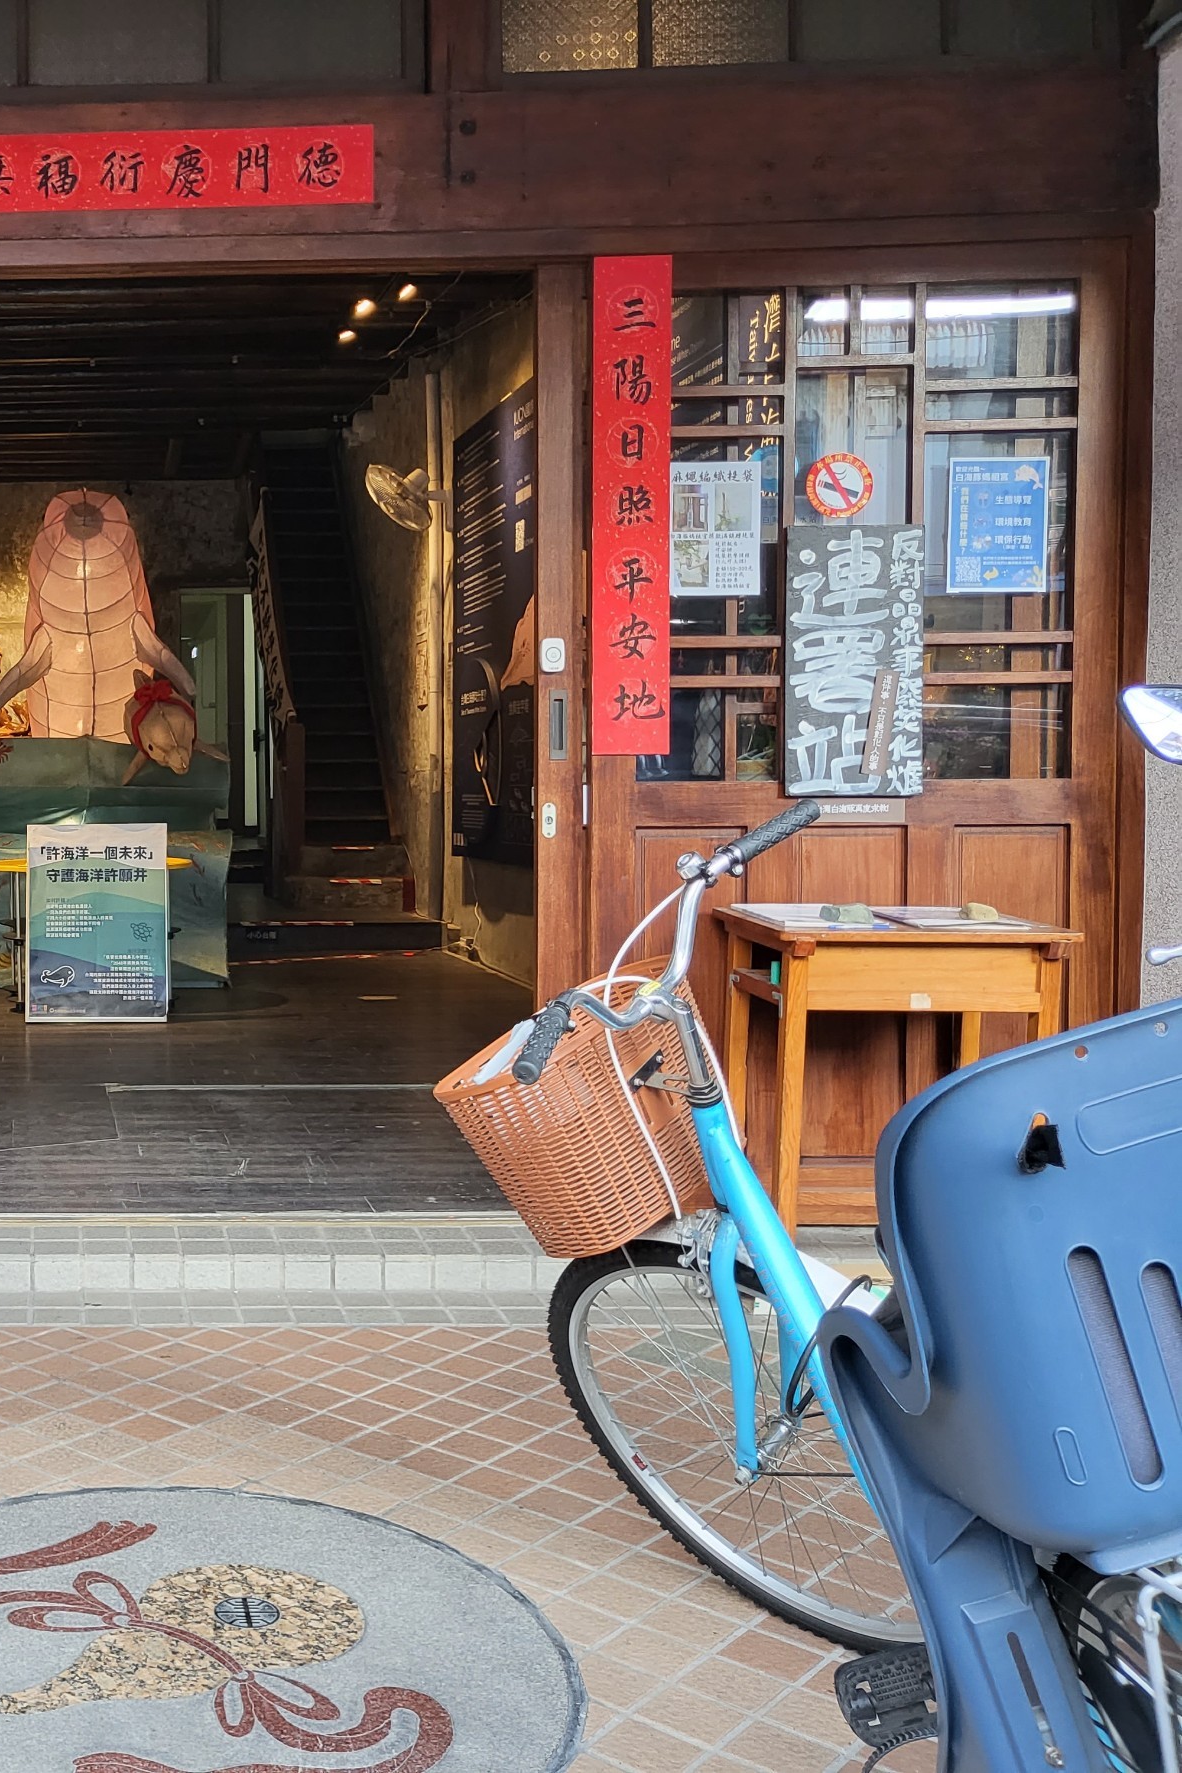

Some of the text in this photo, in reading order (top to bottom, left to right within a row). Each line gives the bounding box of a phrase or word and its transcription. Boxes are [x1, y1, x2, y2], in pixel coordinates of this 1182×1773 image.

[671, 469, 755, 483] 麻繩編織提袋
[610, 297, 665, 722] 三陽日照平安地
[994, 517, 1032, 527] 環境教育
[787, 529, 890, 795] 連署站
[40, 846, 153, 861] 「許海洋一個未來」
[46, 868, 148, 883] 守護海洋許願井
